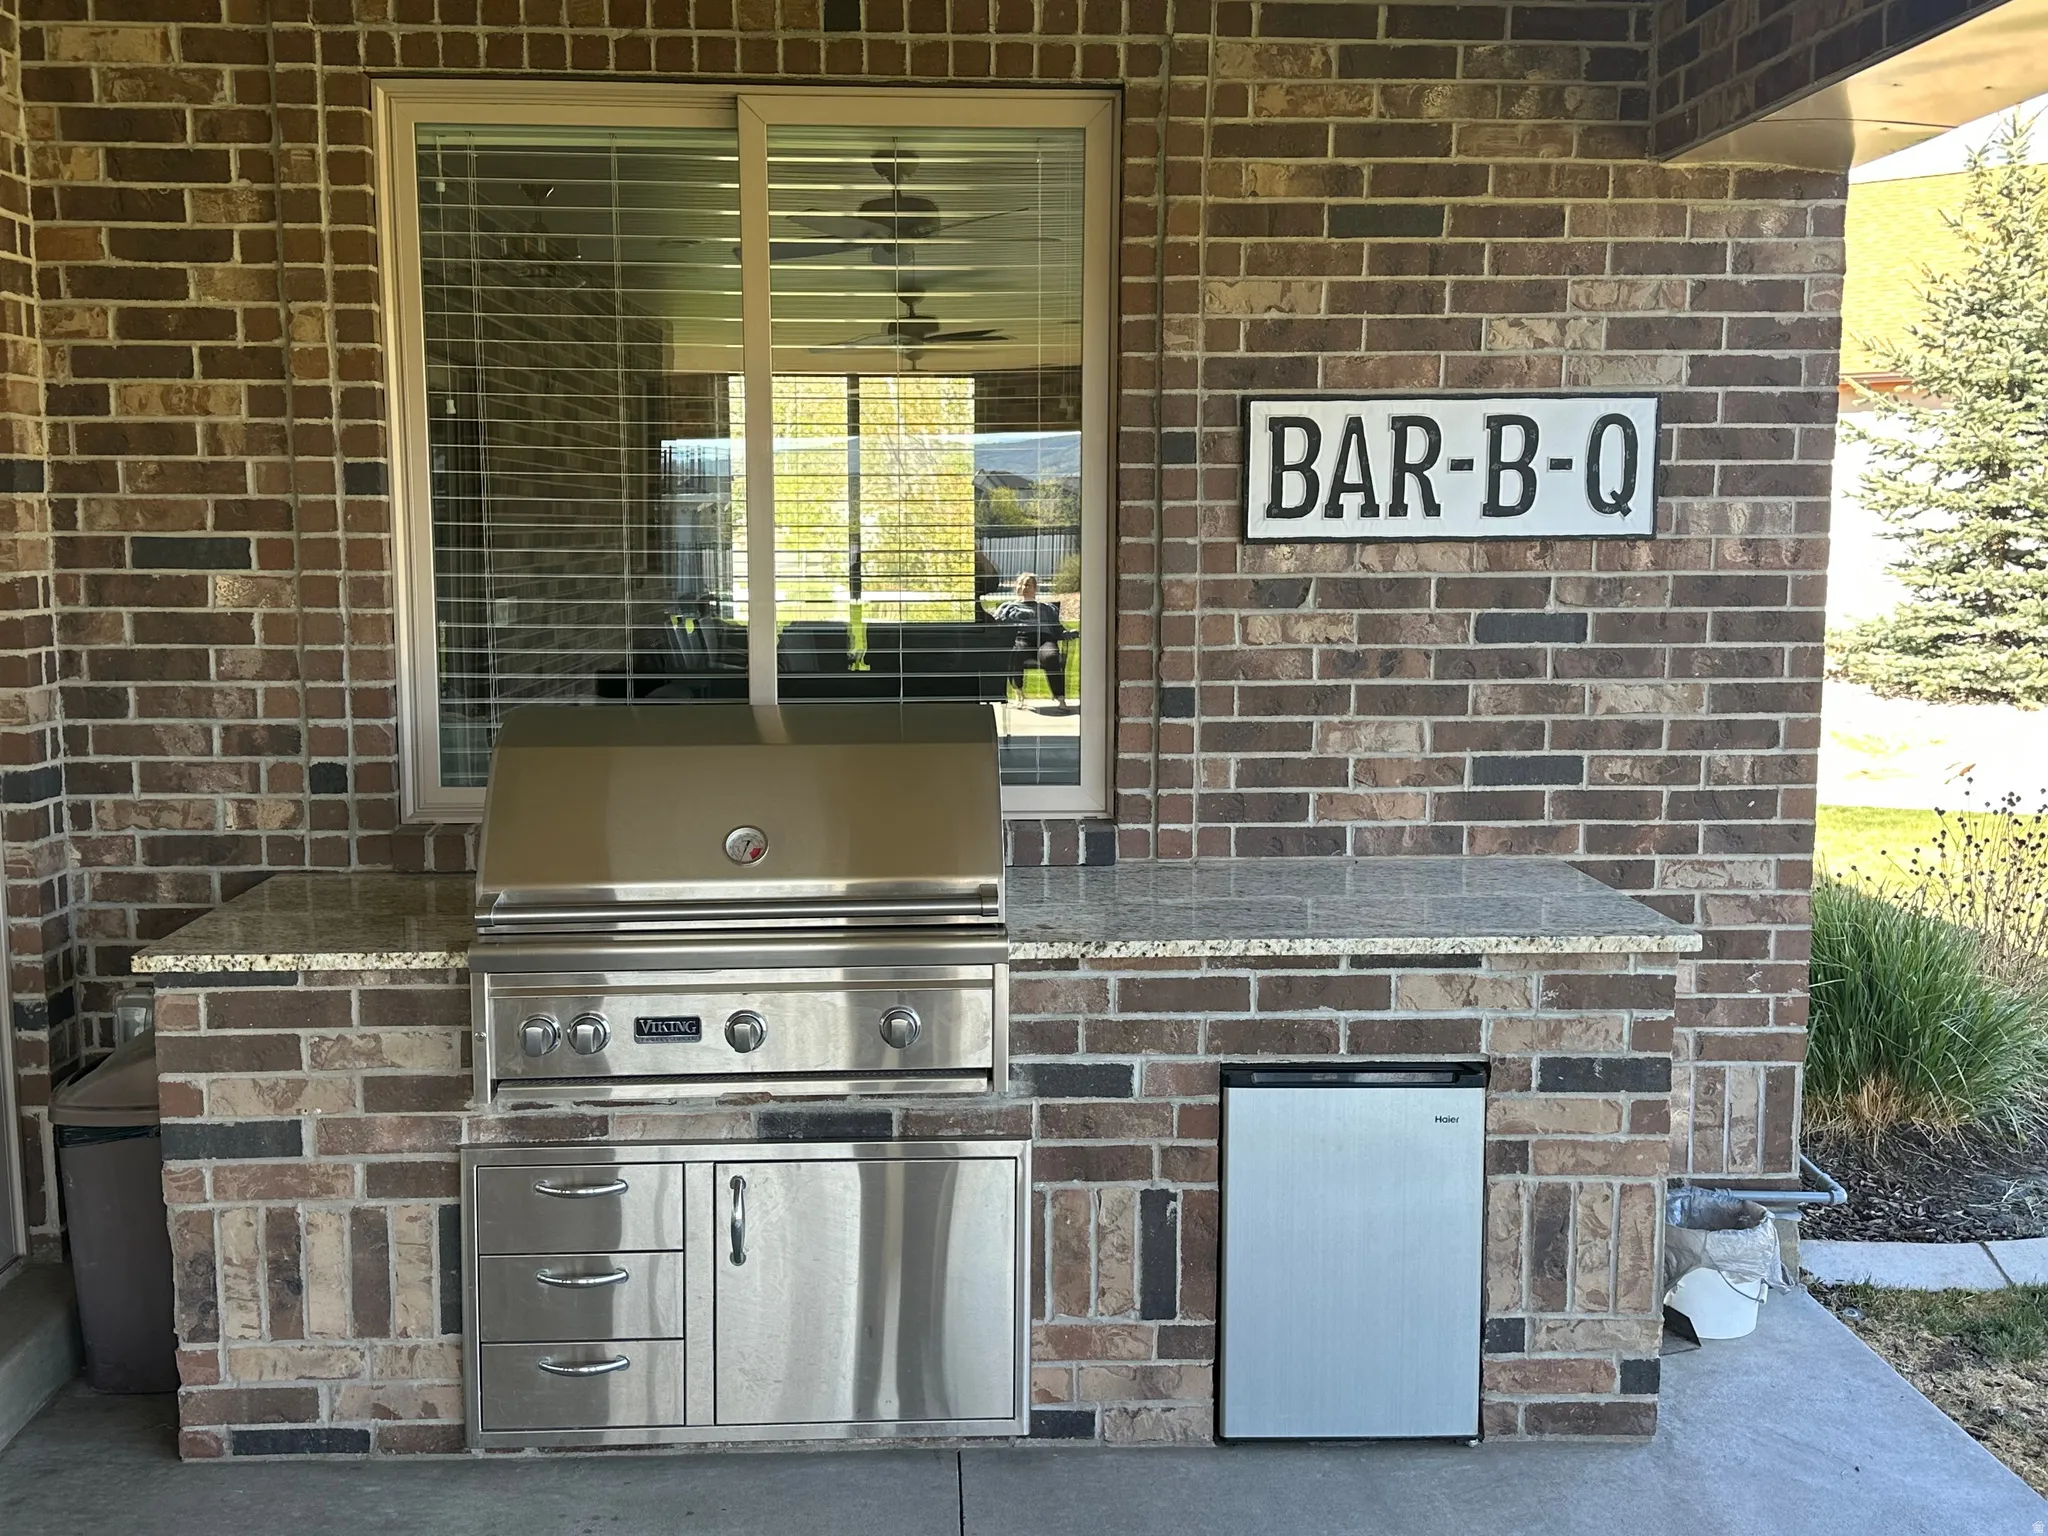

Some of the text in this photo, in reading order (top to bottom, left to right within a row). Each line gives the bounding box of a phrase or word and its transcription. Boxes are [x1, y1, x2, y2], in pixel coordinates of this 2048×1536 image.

[1265, 412, 1640, 519] BAR-B-Q
[638, 1019, 698, 1034] VIKING
[1434, 1114, 1460, 1124] Haier
